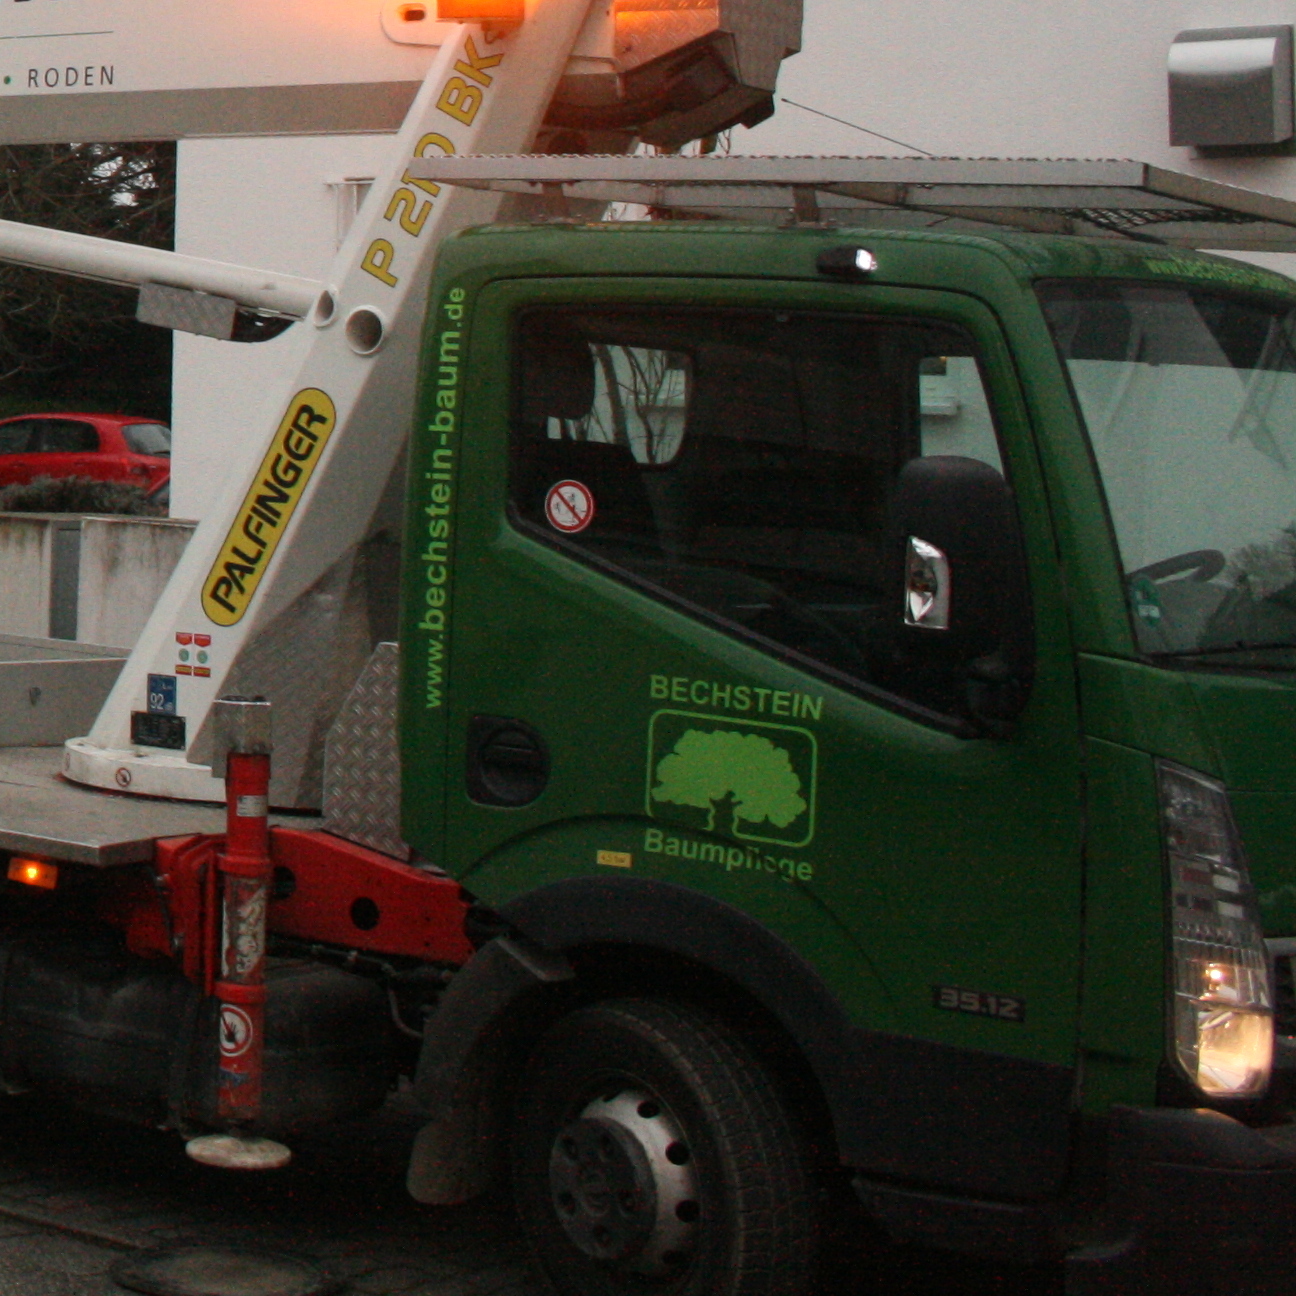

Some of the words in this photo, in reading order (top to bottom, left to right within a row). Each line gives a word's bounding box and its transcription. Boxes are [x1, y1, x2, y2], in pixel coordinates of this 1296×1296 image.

[27, 65, 115, 88] RODEN
[360, 237, 399, 288] P
[436, 34, 505, 127] BK
[209, 404, 329, 614] PALFINGER
[418, 286, 466, 709] www.bechstein-baum.de
[149, 692, 165, 710] 92
[649, 673, 824, 721] BECHSTEIN
[643, 828, 814, 882] Baumpflege
[939, 987, 1021, 1018] 35.12
